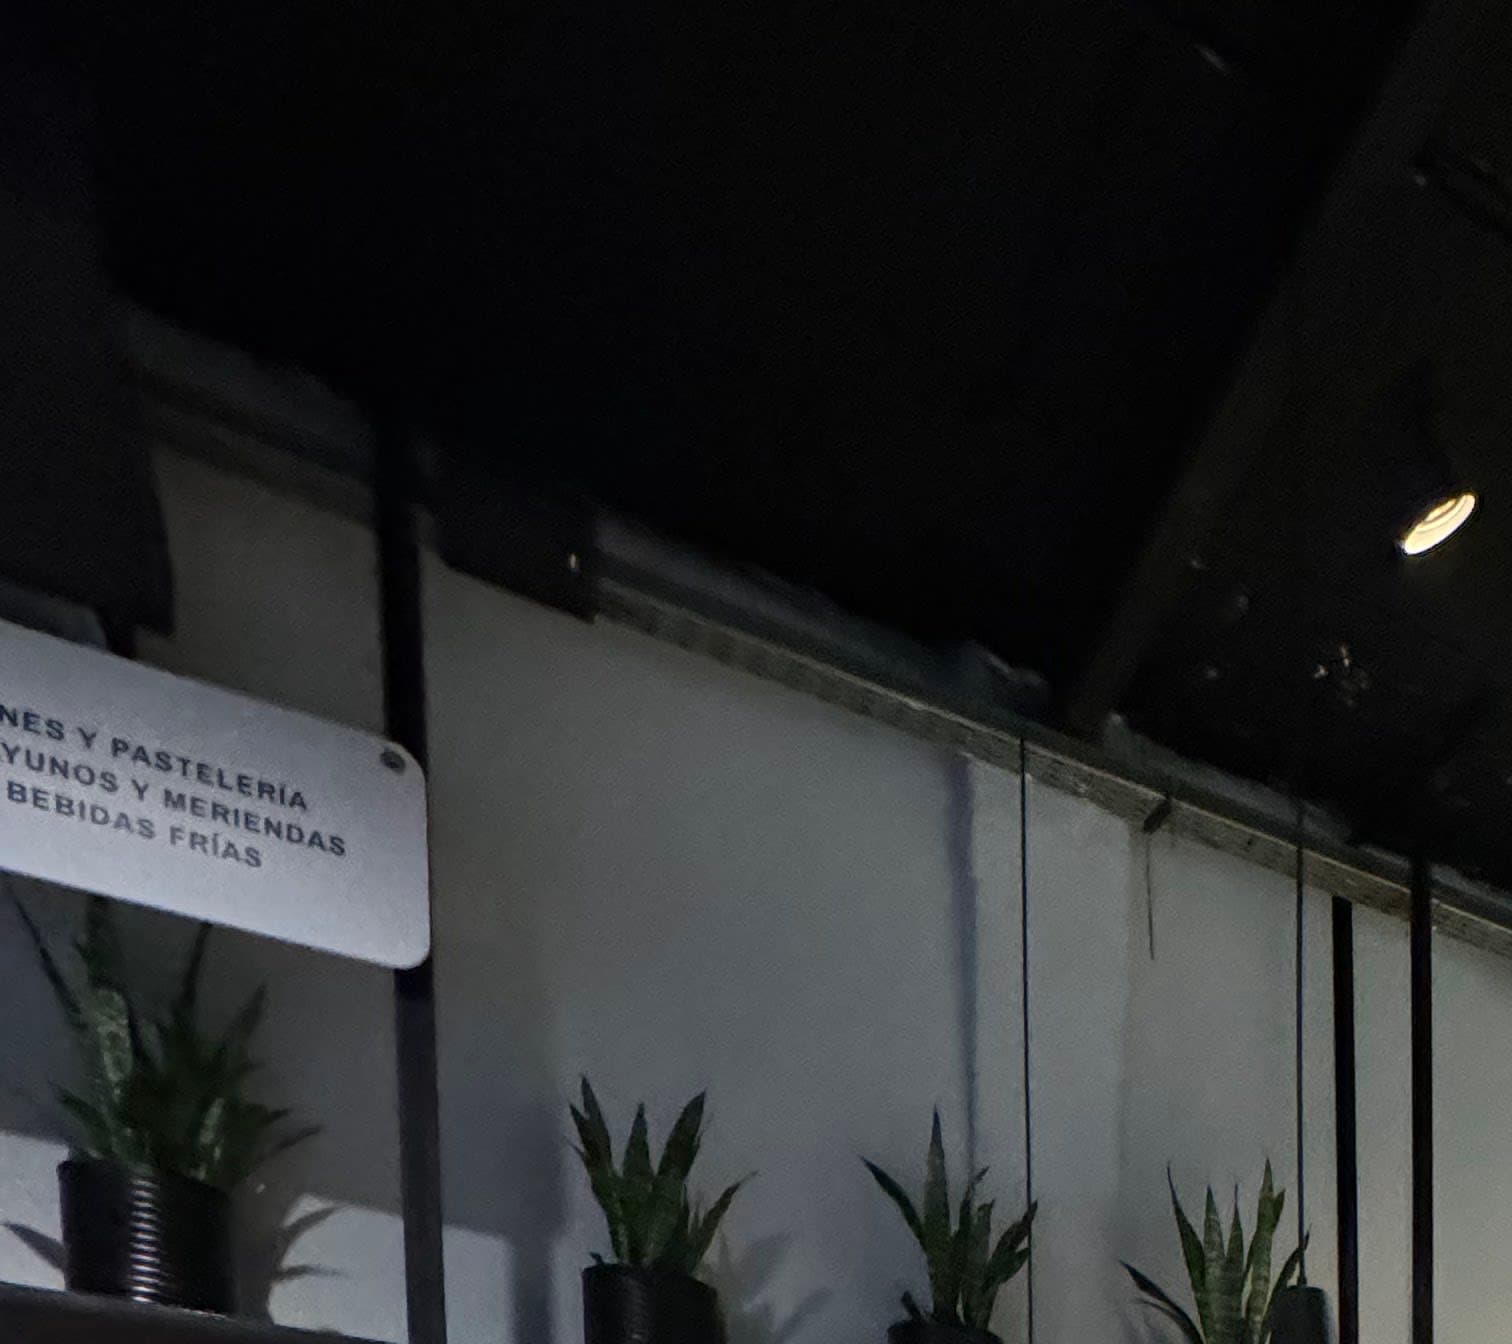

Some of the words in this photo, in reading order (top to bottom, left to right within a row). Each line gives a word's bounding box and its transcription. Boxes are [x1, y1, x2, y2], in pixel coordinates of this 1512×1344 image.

[78, 726, 97, 749] Y
[7, 780, 156, 839] BEBIDAS
[169, 826, 262, 868] FRÍAS
[131, 778, 149, 801] Y
[163, 788, 347, 856] MERIENDAS
